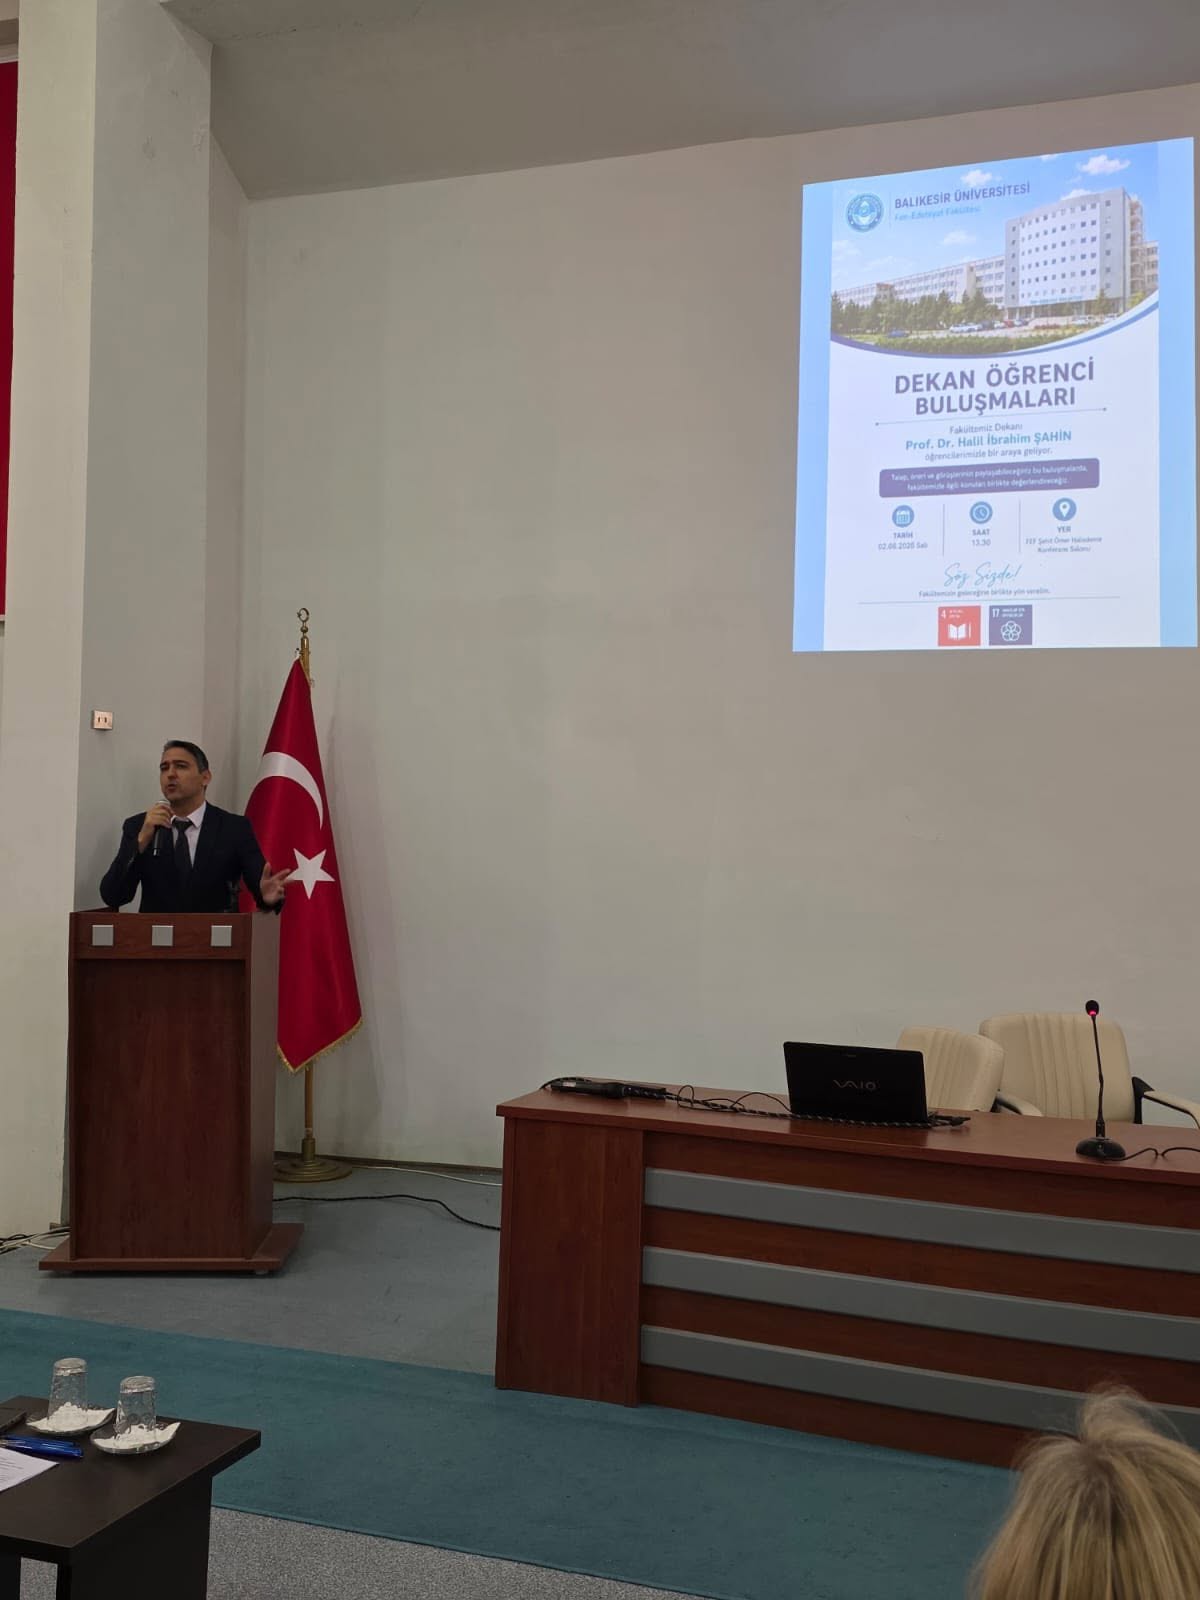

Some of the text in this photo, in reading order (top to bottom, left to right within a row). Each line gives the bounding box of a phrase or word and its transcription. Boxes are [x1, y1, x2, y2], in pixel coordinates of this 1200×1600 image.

[895, 181, 1031, 209] BALIKESİR ÜNİVERSİTESİ
[895, 356, 1094, 394] DEKAN ÖĞRENCİ
[916, 387, 1076, 416] BULUŞMALARI
[950, 421, 1023, 435] Fakültemiz Dekanı
[906, 429, 1072, 450] Prof. Dr. Halil İbrahim ŞAHİN
[925, 446, 1053, 463] öğrencilerimizle bir araya geliyor.
[893, 531, 914, 540] TARİH
[972, 528, 991, 537] SAAT
[1057, 526, 1071, 534] YER
[944, 561, 1023, 589] Söz Sizde!
[941, 609, 947, 619] 4
[992, 607, 1000, 618] 17
[833, 1079, 877, 1092] VAIO
